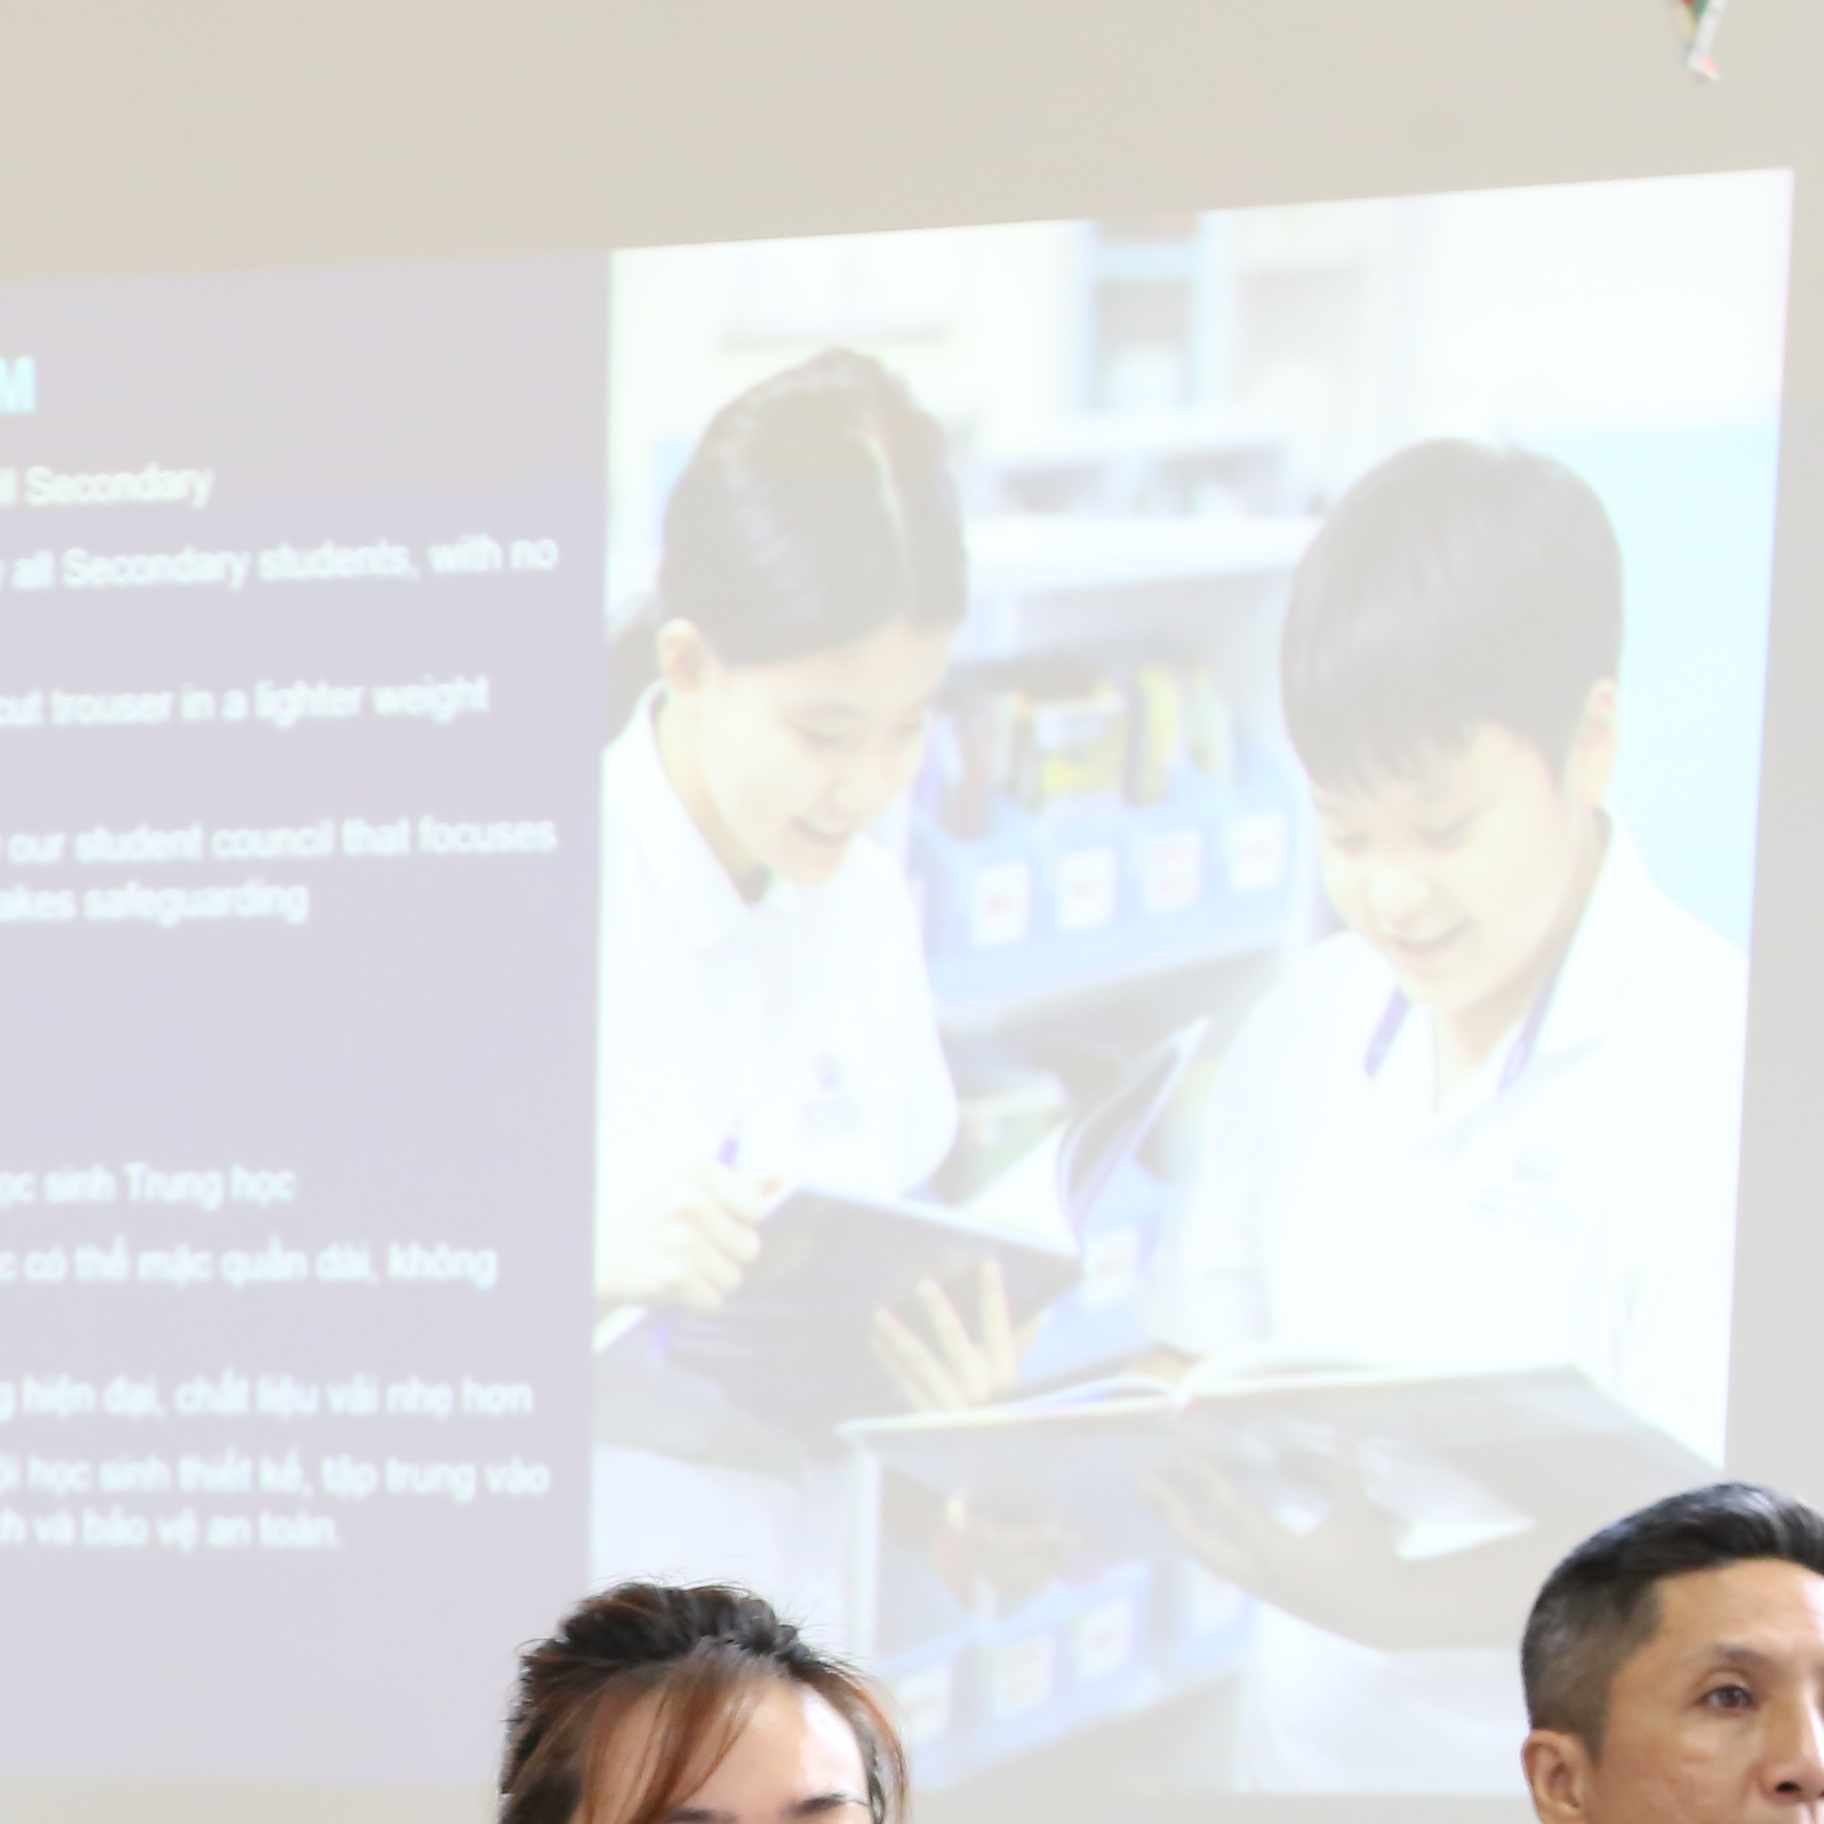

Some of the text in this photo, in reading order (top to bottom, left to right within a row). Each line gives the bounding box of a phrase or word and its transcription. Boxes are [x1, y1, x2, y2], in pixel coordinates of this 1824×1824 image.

[25, 463, 213, 508] Secondary
[12, 551, 54, 589] all
[62, 547, 251, 590] Secondary
[257, 541, 417, 581] students,
[428, 534, 503, 573] with
[510, 539, 558, 570] no
[50, 691, 173, 725] trouser
[180, 689, 215, 720] in
[222, 690, 248, 720] a
[255, 681, 363, 728] lighter
[372, 675, 489, 724] weight
[8, 833, 65, 864] our
[74, 824, 203, 863] student
[210, 820, 335, 859] council
[341, 818, 410, 856] that
[418, 815, 557, 854] focuses
[83, 880, 309, 927] safeguarding
